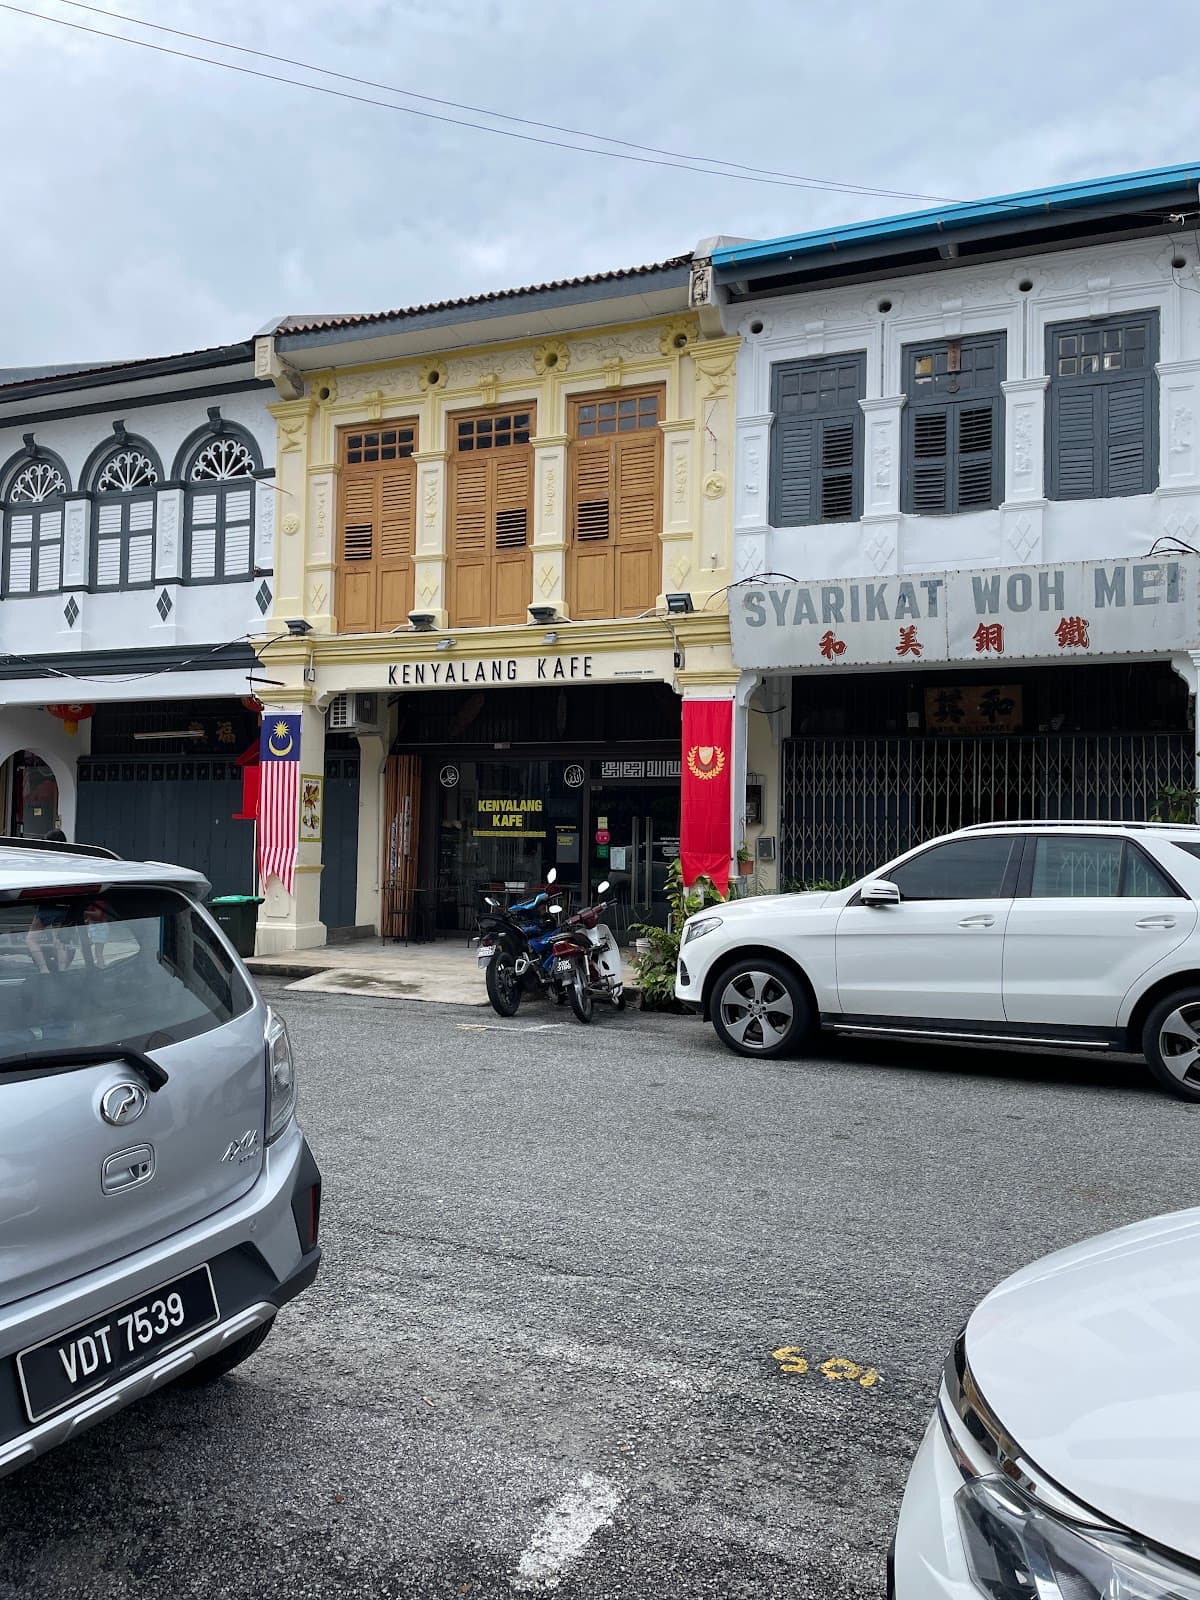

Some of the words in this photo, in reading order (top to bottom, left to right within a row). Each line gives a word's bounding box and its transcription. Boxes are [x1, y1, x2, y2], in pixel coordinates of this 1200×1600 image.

[744, 578, 944, 628] SYARIKAT
[971, 570, 1065, 615] WOH
[1094, 562, 1180, 609] MEI
[388, 660, 517, 685] KENYALANG
[537, 656, 593, 679] KAFE
[478, 799, 543, 812] KENYALANG
[492, 814, 523, 827] KAFE
[58, 1323, 112, 1385] VDT
[117, 1292, 185, 1352] 7539
